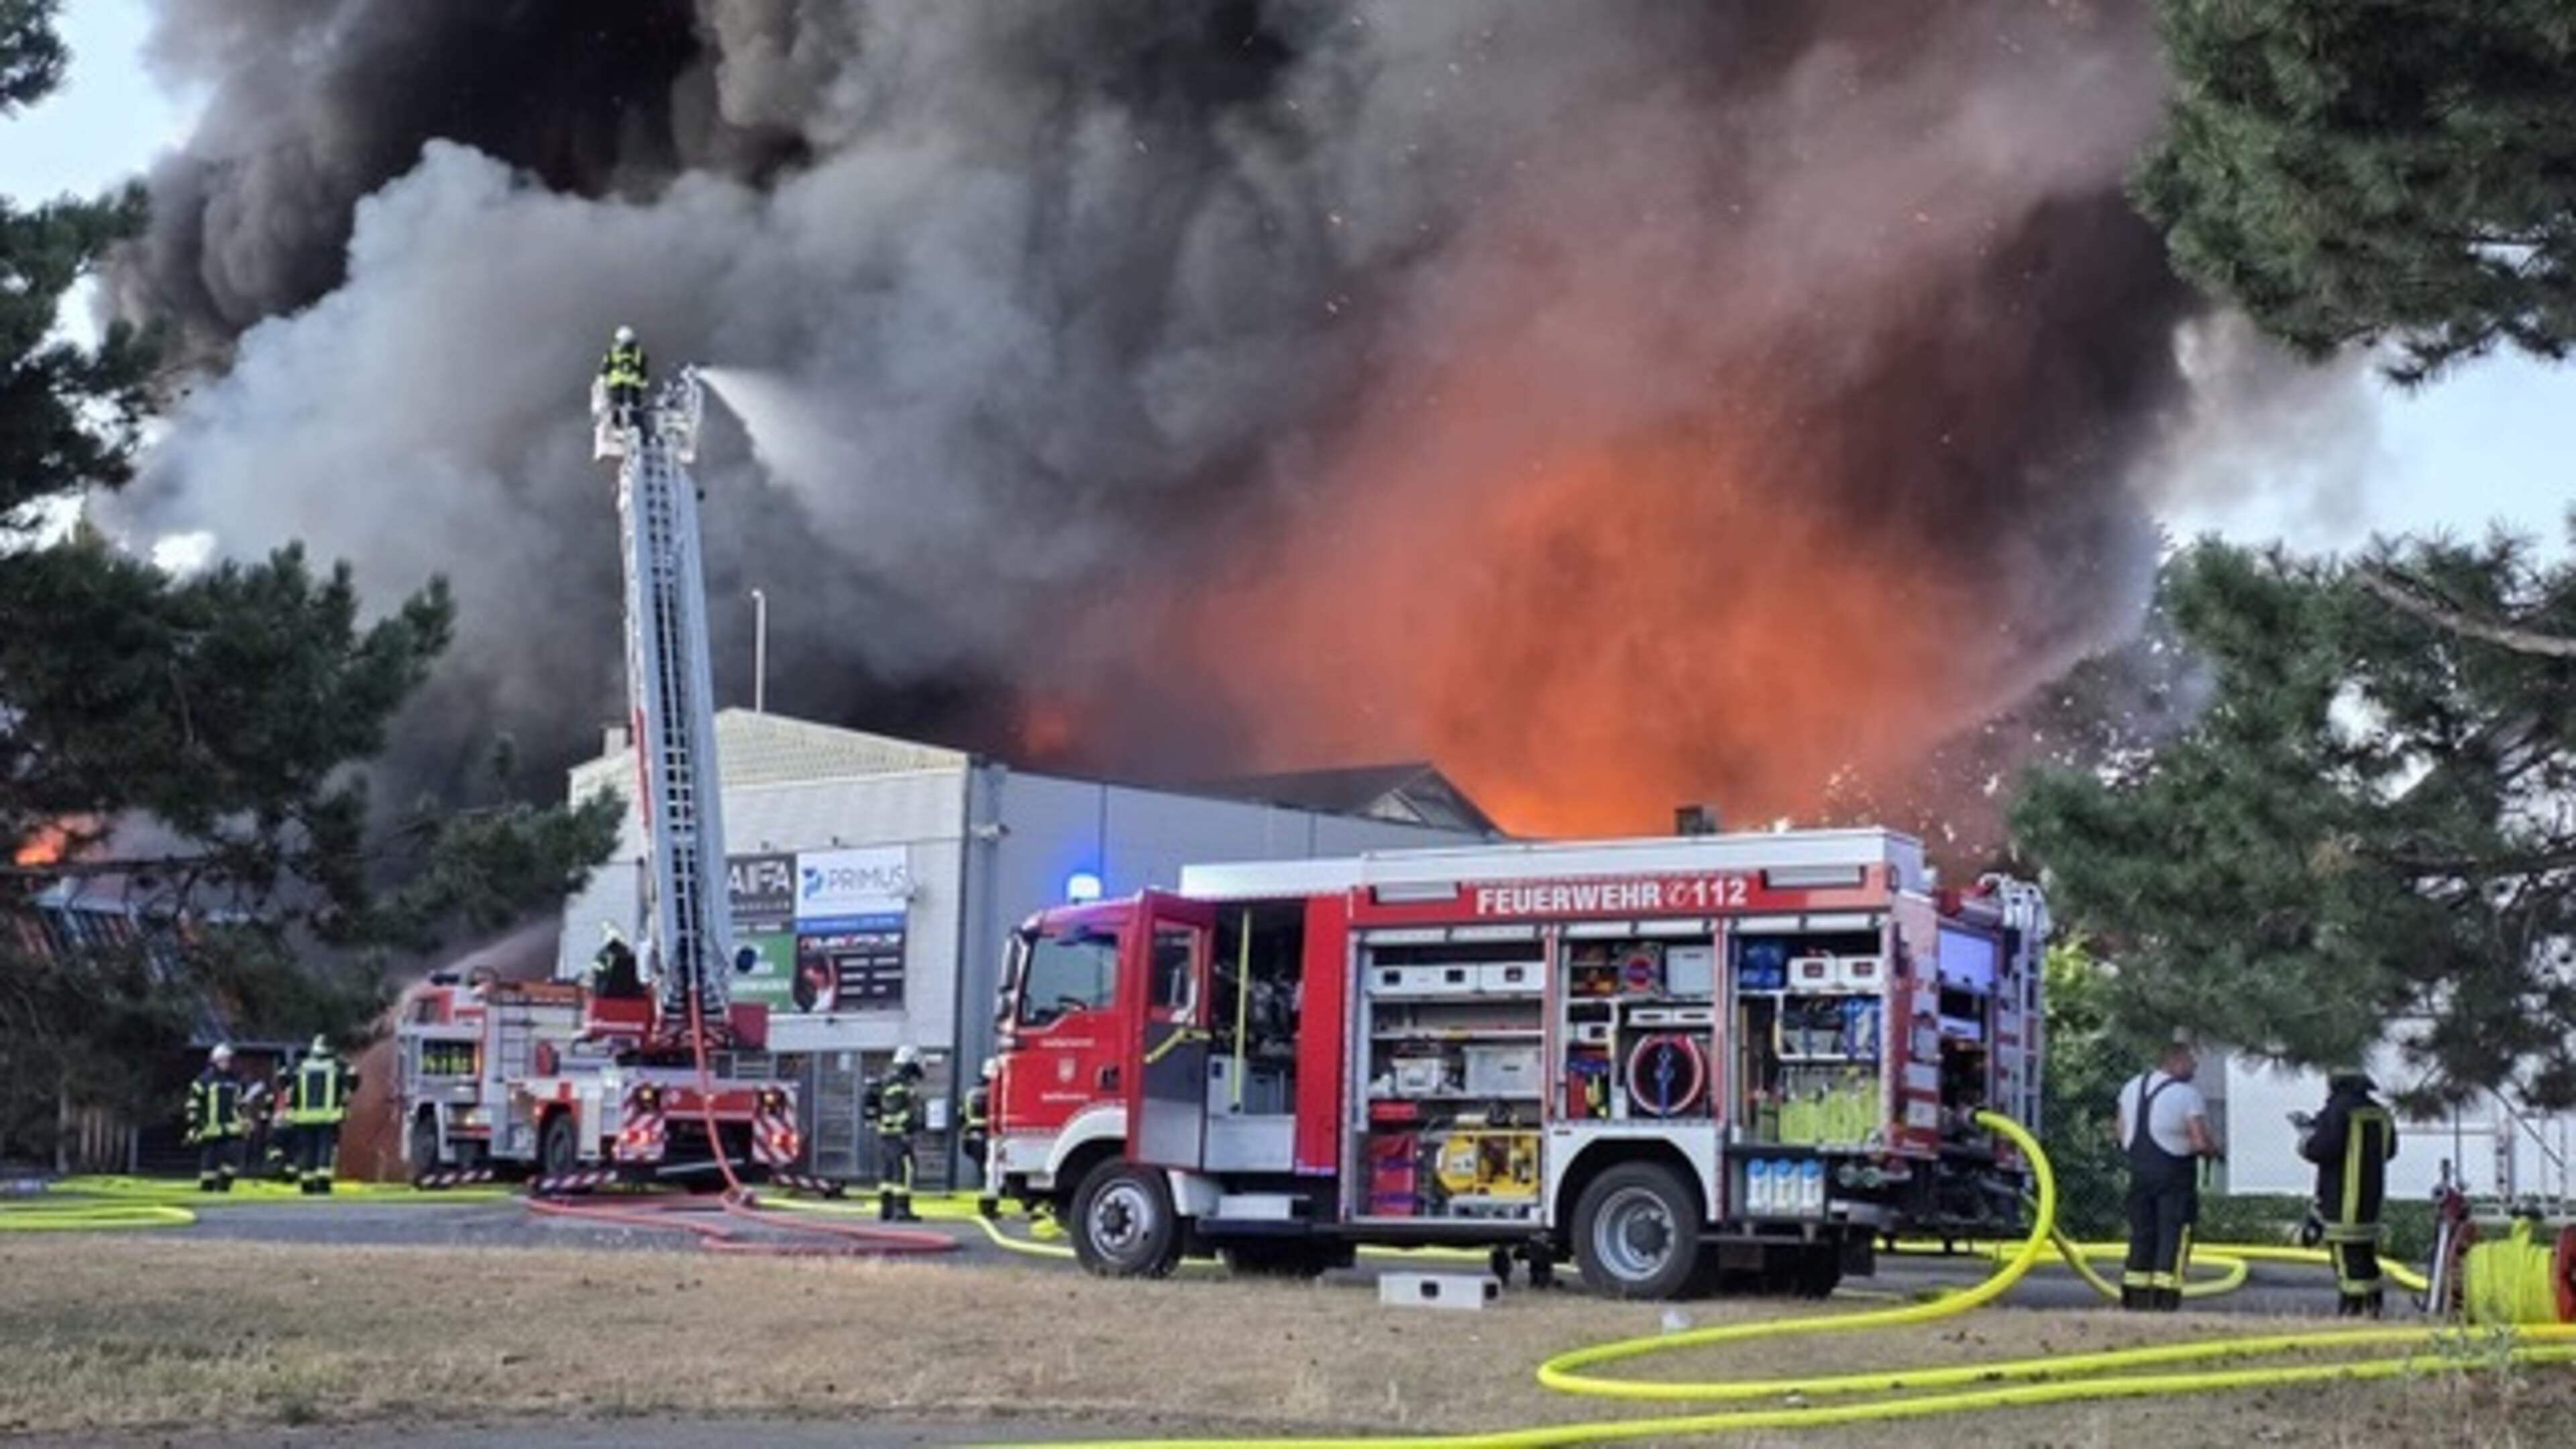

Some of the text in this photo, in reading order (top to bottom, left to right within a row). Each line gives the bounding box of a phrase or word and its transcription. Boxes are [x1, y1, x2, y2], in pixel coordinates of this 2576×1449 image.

[728, 861, 791, 894] AIFA
[828, 864, 906, 890] PRIMUS
[1476, 877, 1748, 914] FEUERWEHR 112
